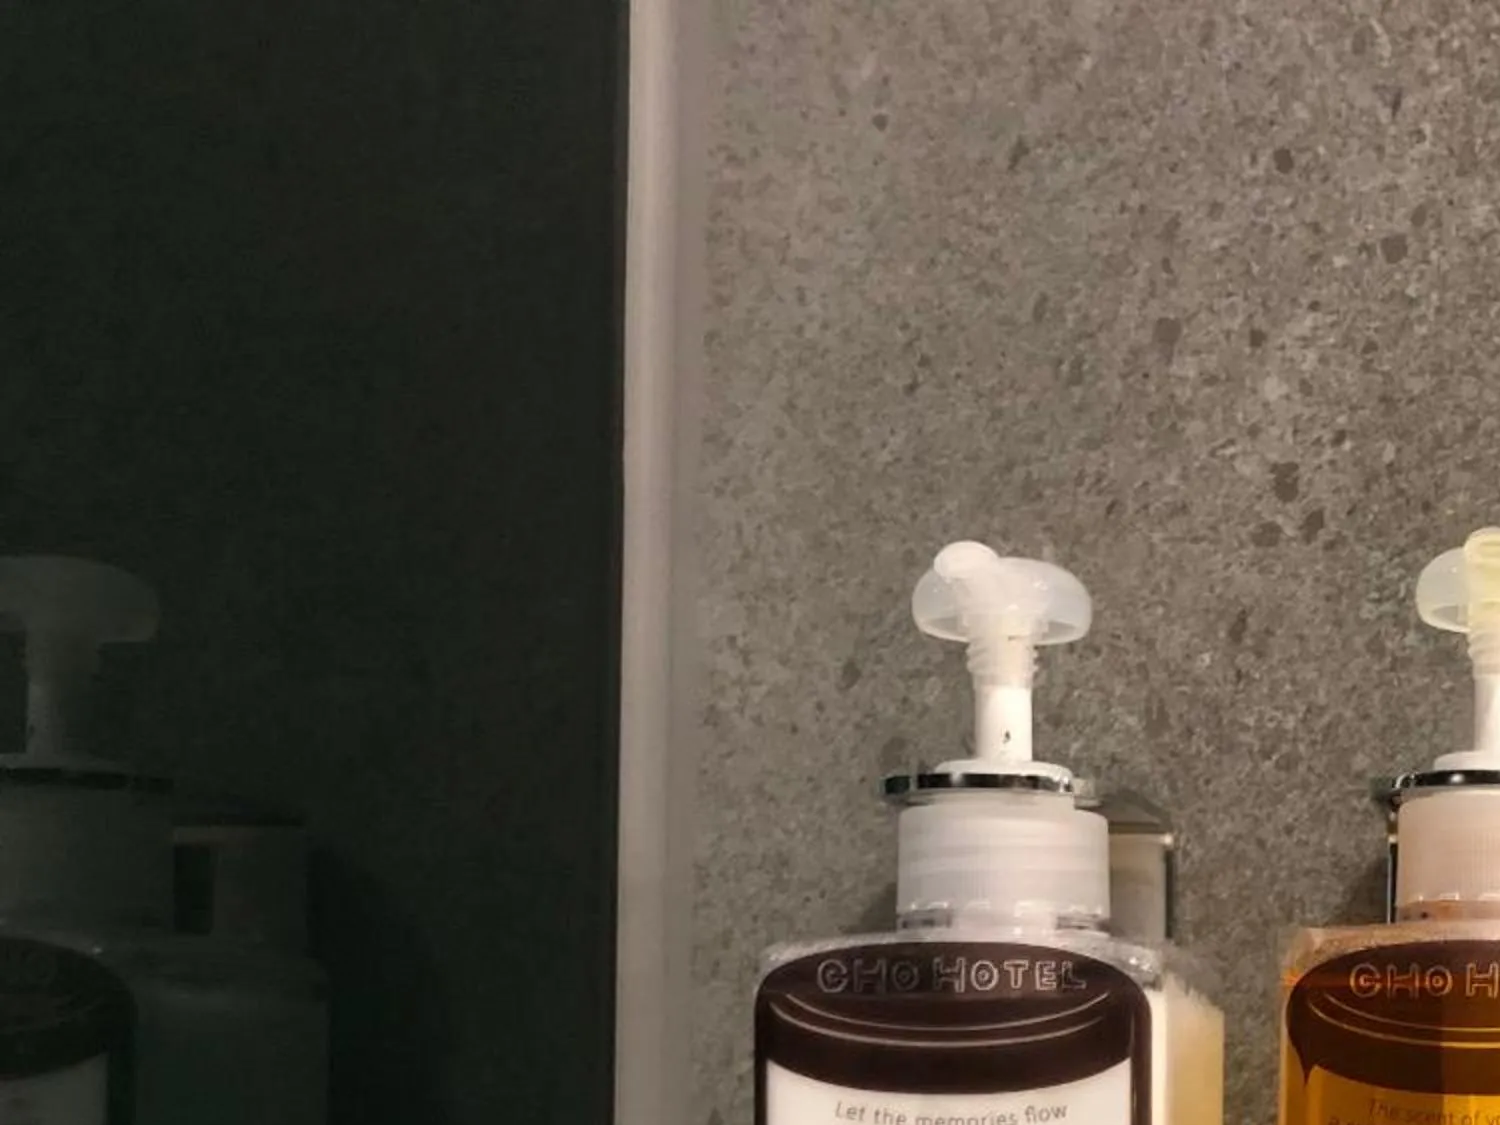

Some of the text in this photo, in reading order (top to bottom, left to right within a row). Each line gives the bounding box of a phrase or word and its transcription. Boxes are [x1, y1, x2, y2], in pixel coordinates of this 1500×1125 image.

[816, 956, 1087, 994] CHO HOTEL
[1348, 962, 1454, 999] CHO
[835, 1100, 865, 1122] Let
[1024, 1104, 1068, 1124] flow
